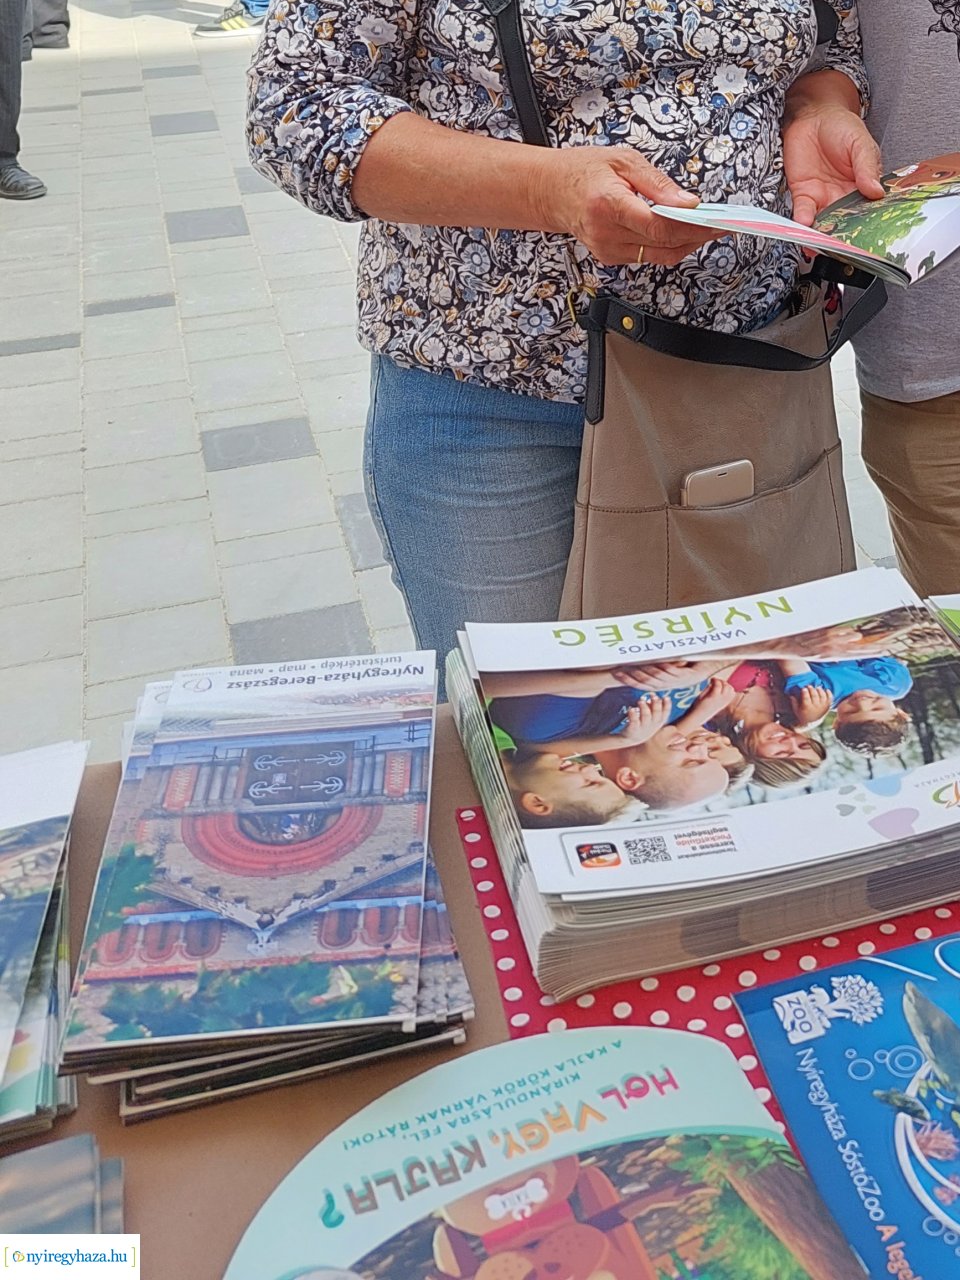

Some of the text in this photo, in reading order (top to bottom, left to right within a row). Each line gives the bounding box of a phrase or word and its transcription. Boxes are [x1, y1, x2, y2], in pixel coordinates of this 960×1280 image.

[552, 596, 793, 647] NYÍRSÉG
[618, 629, 747, 654] VARÁZSLATOS
[226, 665, 424, 690] Nyíregyháza-Beregszász
[278, 656, 402, 674] turistatérkép map
[786, 999, 813, 1033] ZOO
[342, 1040, 622, 1151] A KAJLA KÖRÖK VÁRNAK RÁTOK!
[401, 1071, 580, 1142] KIRÁNDULÁSRA FEL,
[795, 1047, 922, 1280] Nyíregyháza SóstóZoo A lege
